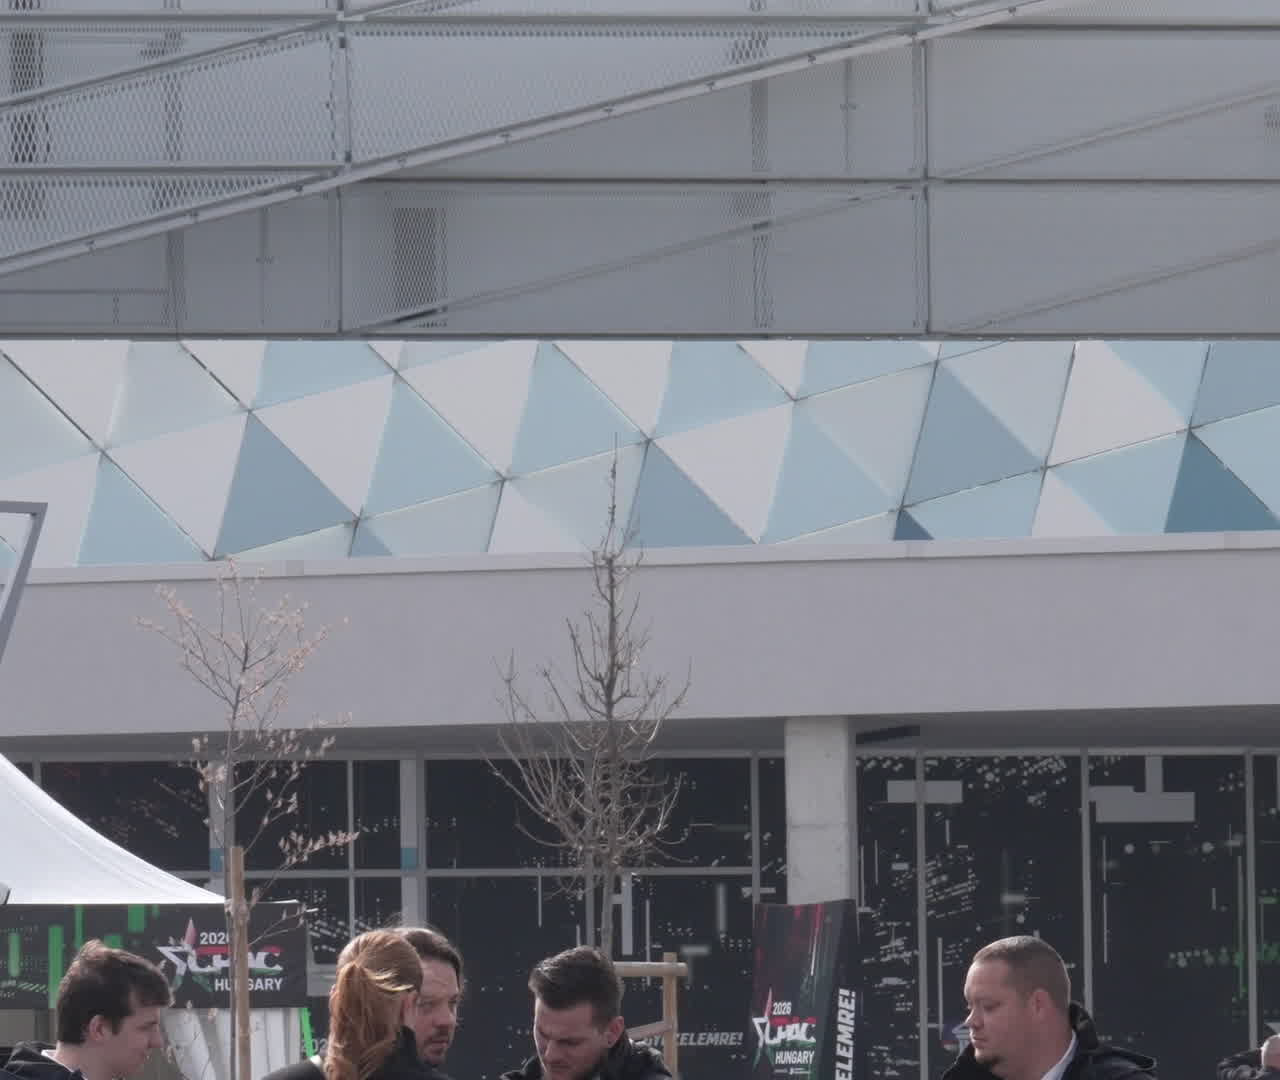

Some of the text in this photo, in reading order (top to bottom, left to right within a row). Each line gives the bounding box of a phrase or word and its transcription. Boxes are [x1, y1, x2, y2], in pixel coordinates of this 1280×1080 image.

[215, 978, 283, 991] HUGARY
[772, 1002, 792, 1015] 2026
[775, 1050, 815, 1065] HUNGARY
